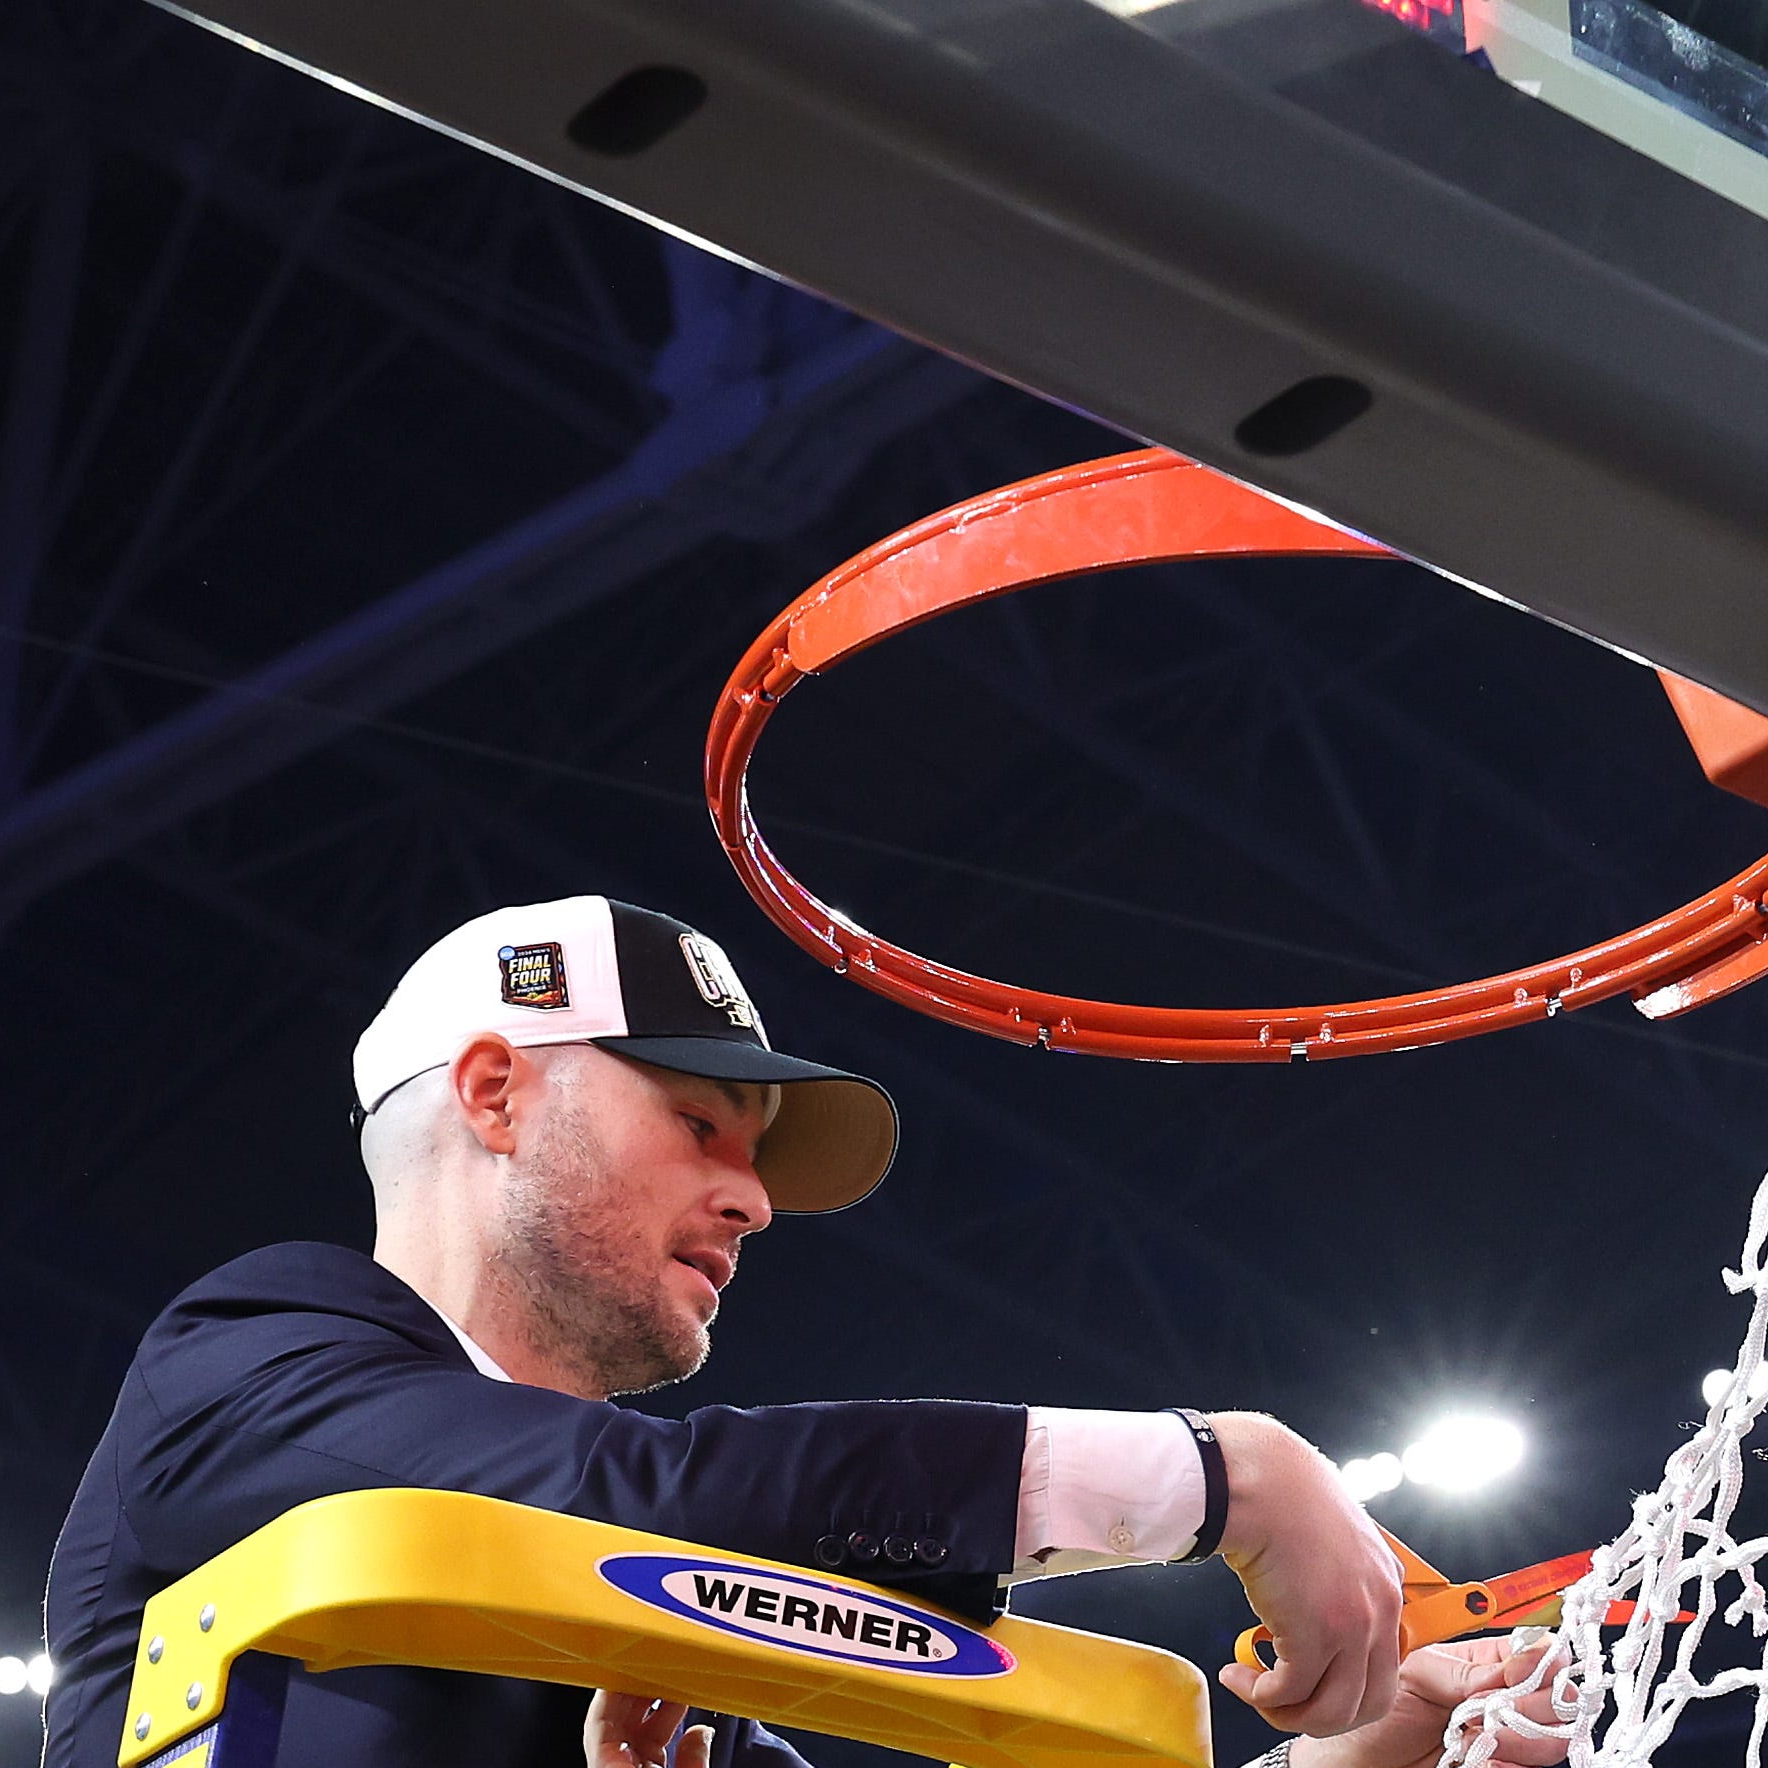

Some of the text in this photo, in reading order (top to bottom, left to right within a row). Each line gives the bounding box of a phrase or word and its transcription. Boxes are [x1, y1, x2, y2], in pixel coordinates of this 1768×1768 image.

[508, 954, 552, 974] FINAL
[510, 968, 551, 990] FOUR
[692, 1574, 933, 1658] WERNER
